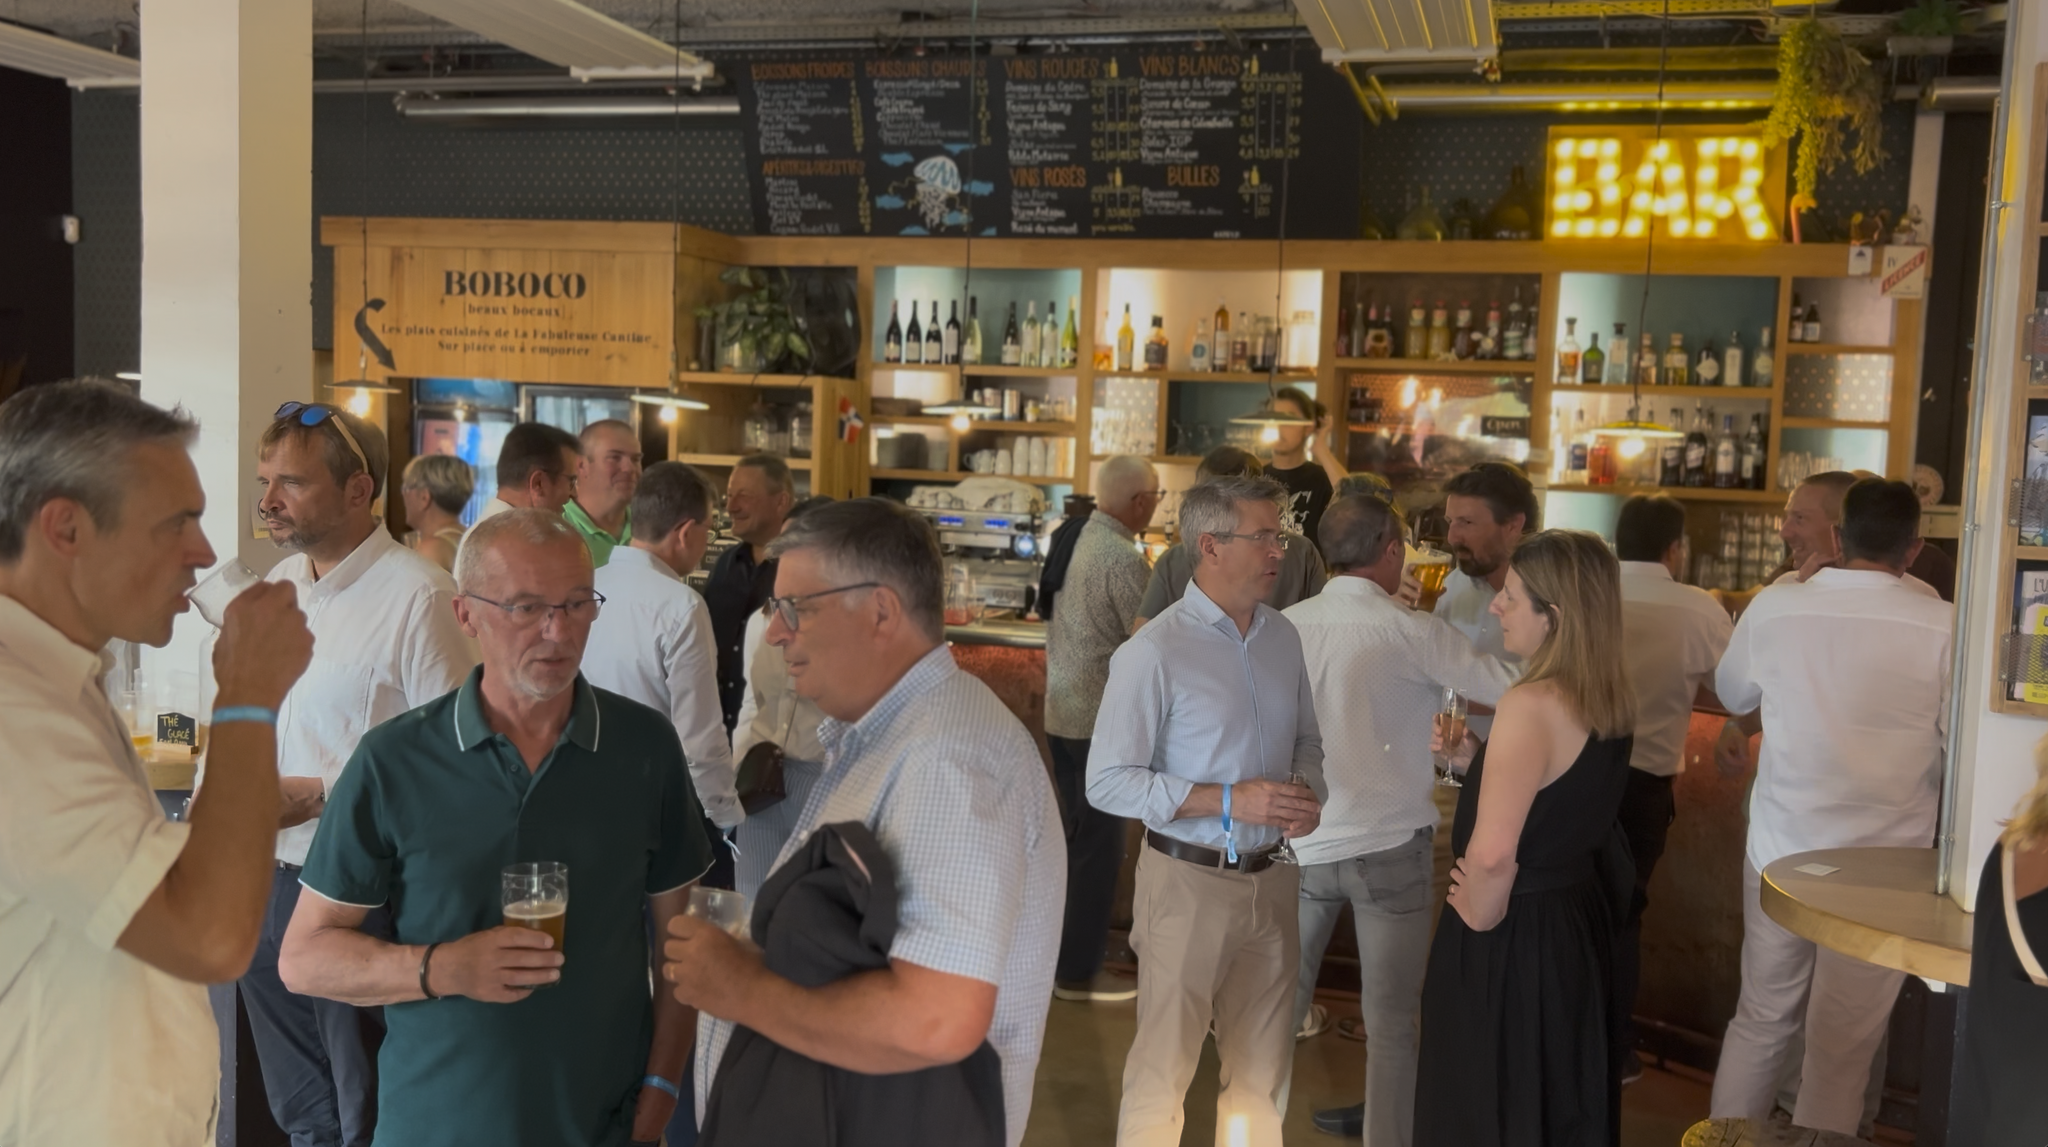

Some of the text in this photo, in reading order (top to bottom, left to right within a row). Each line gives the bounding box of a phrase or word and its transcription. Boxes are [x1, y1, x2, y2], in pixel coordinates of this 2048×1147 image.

[751, 61, 855, 80] BOISSONS FROIDES
[865, 61, 928, 78] BOISSONS
[1004, 57, 1099, 79] VINS ROUGES
[1139, 54, 1240, 77] VINS BLANCS
[1010, 164, 1086, 187] VINS ROSÉS
[1167, 165, 1220, 187] BULLES
[1551, 136, 1777, 240] BAR
[444, 270, 587, 299] BOBOCO
[468, 303, 562, 318] beaux bocaux
[382, 324, 652, 345] Les plats cuisinés de La Fabuleuse Cantine
[438, 340, 591, 357] Sur place ou à emporter
[1486, 417, 1521, 434] Open
[160, 715, 179, 727] THÉ
[168, 728, 190, 740] GLACÉ
